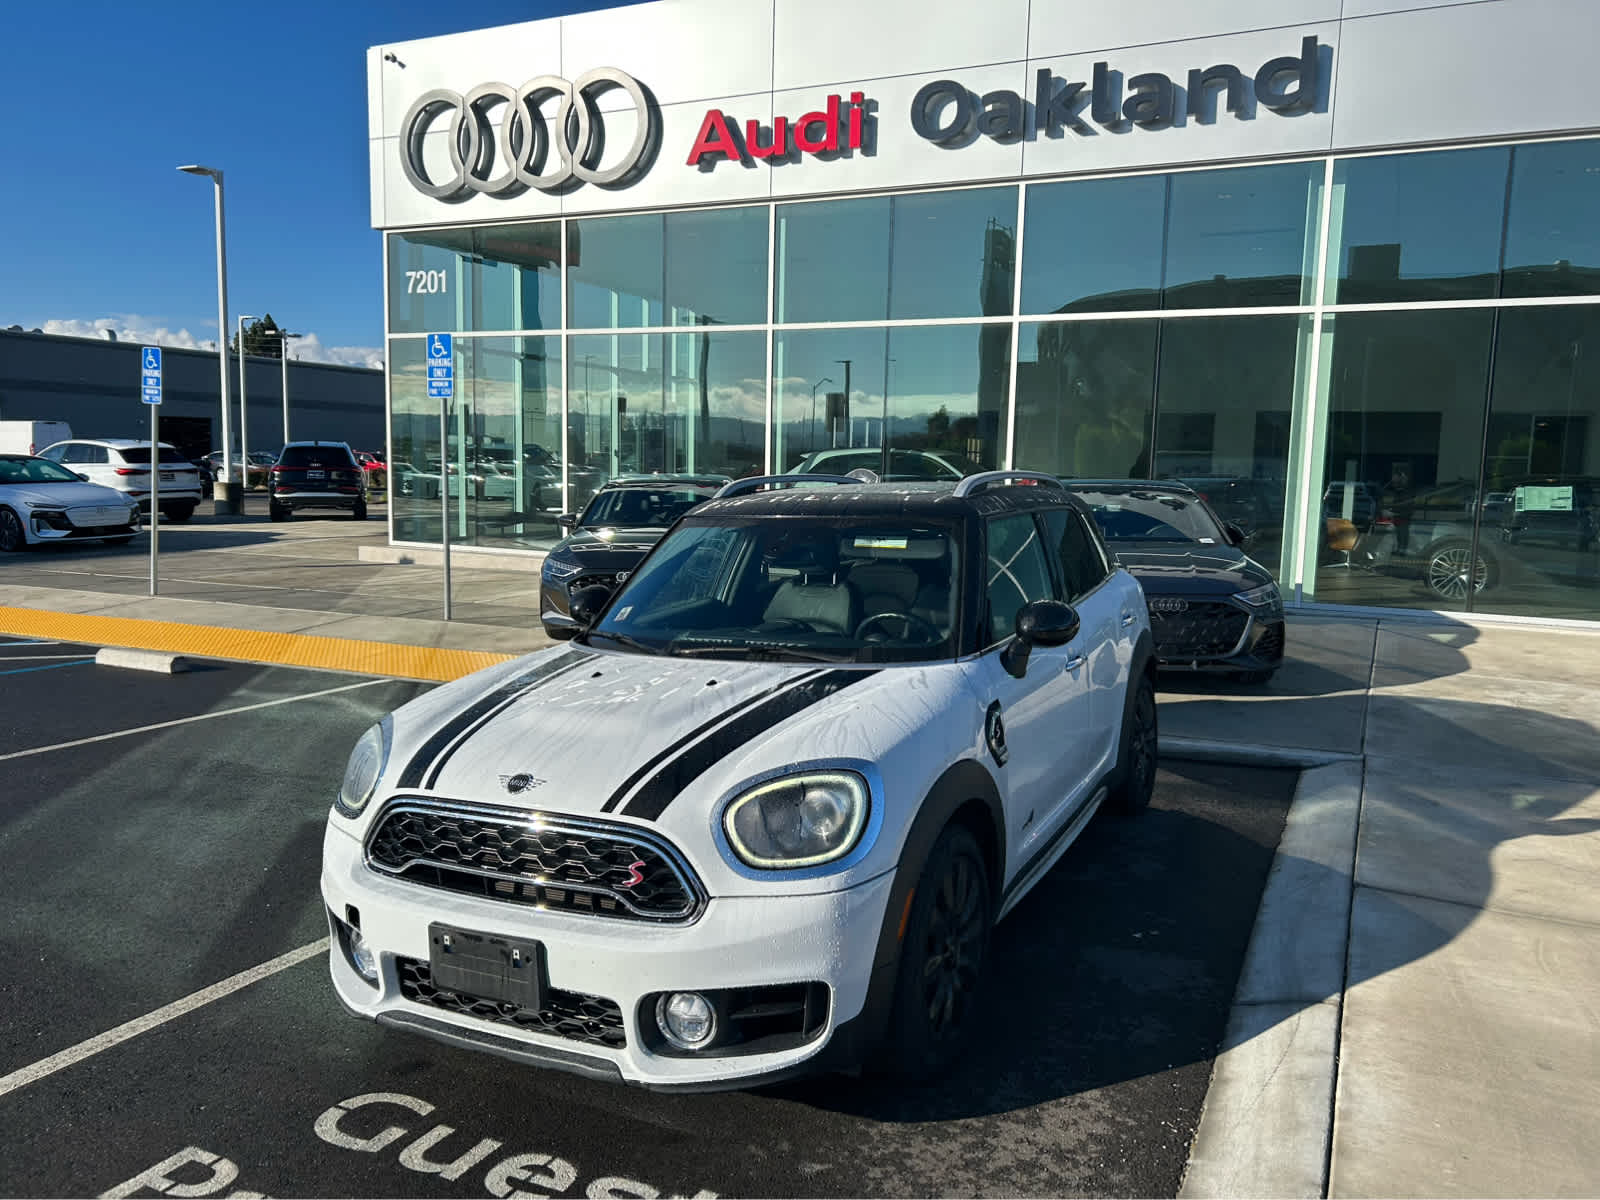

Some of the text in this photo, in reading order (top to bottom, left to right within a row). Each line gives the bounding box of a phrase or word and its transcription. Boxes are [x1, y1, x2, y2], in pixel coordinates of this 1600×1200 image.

[687, 35, 1320, 168] Audi Oakland
[405, 269, 447, 294] 7201
[622, 860, 646, 887] S
[313, 1092, 719, 1200] Gue
